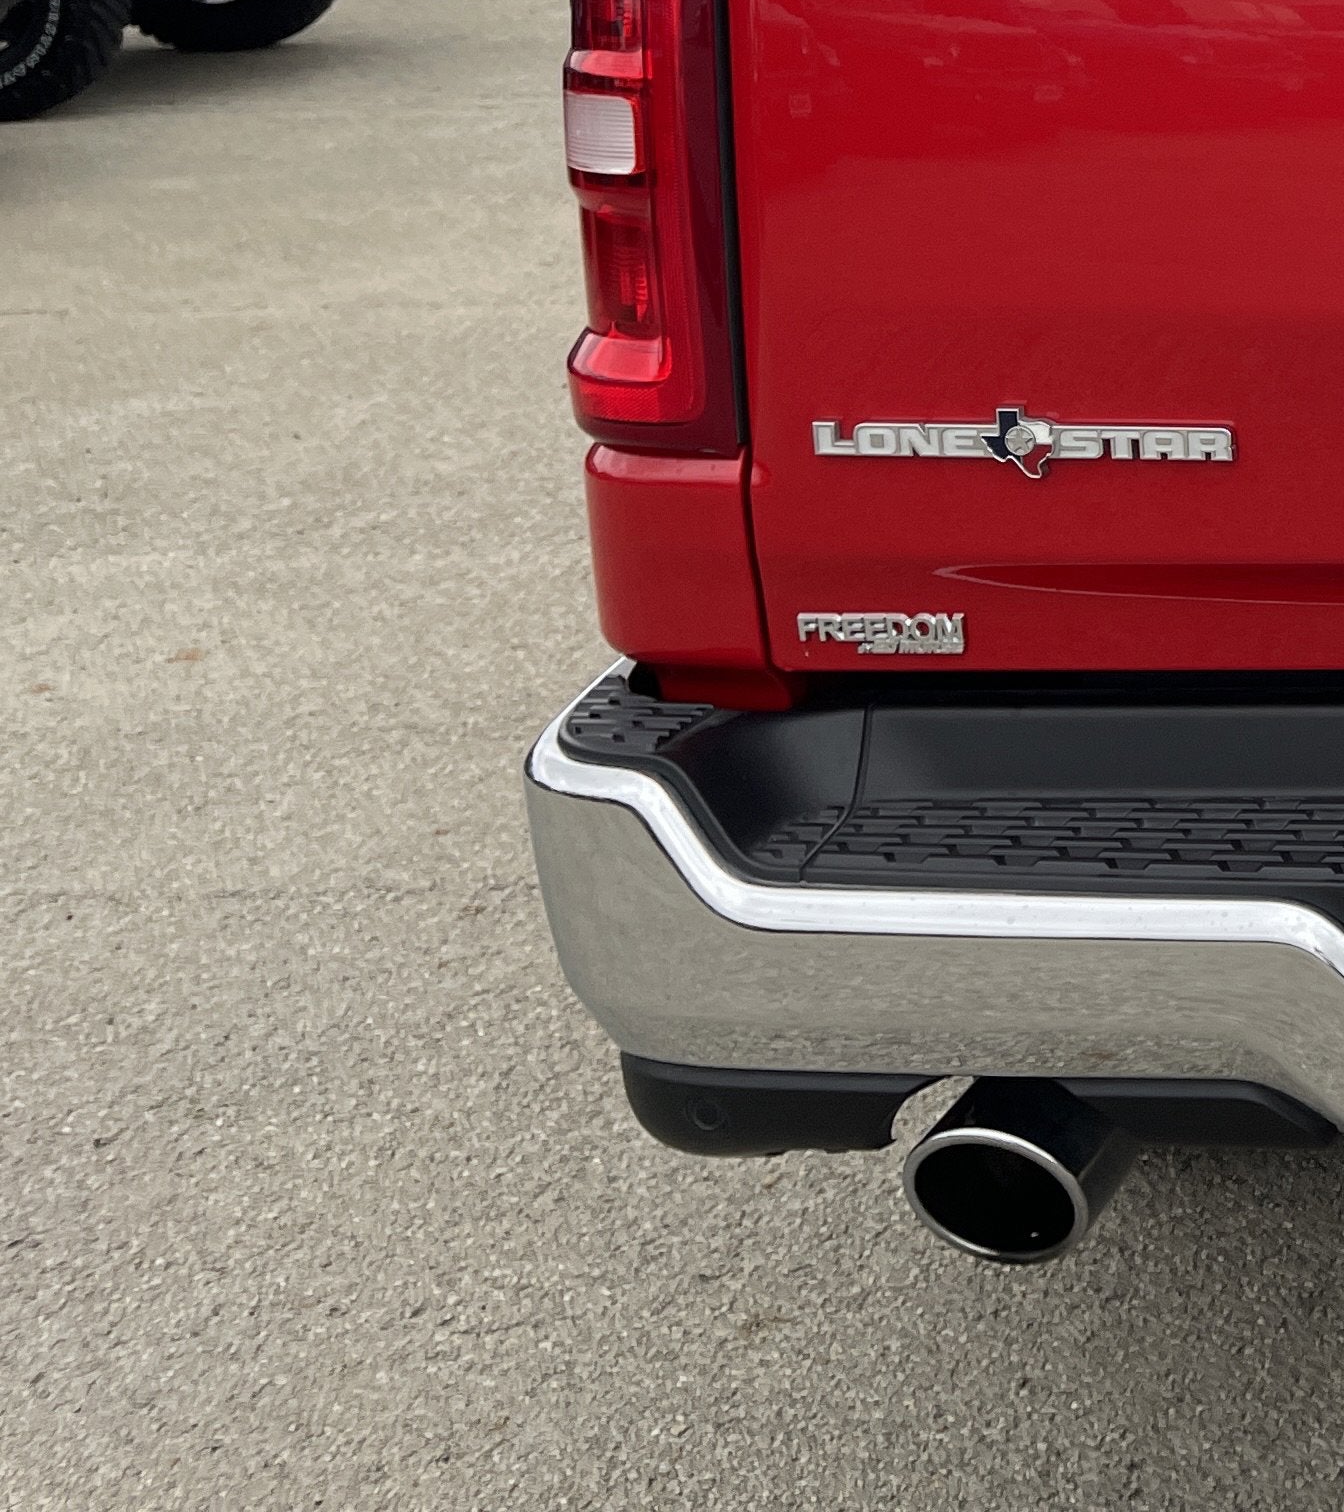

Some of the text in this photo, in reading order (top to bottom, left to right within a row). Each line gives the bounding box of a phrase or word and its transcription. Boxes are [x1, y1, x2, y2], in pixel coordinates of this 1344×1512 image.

[812, 421, 1234, 461] LONE STAR
[797, 612, 964, 642] FREEDOM
